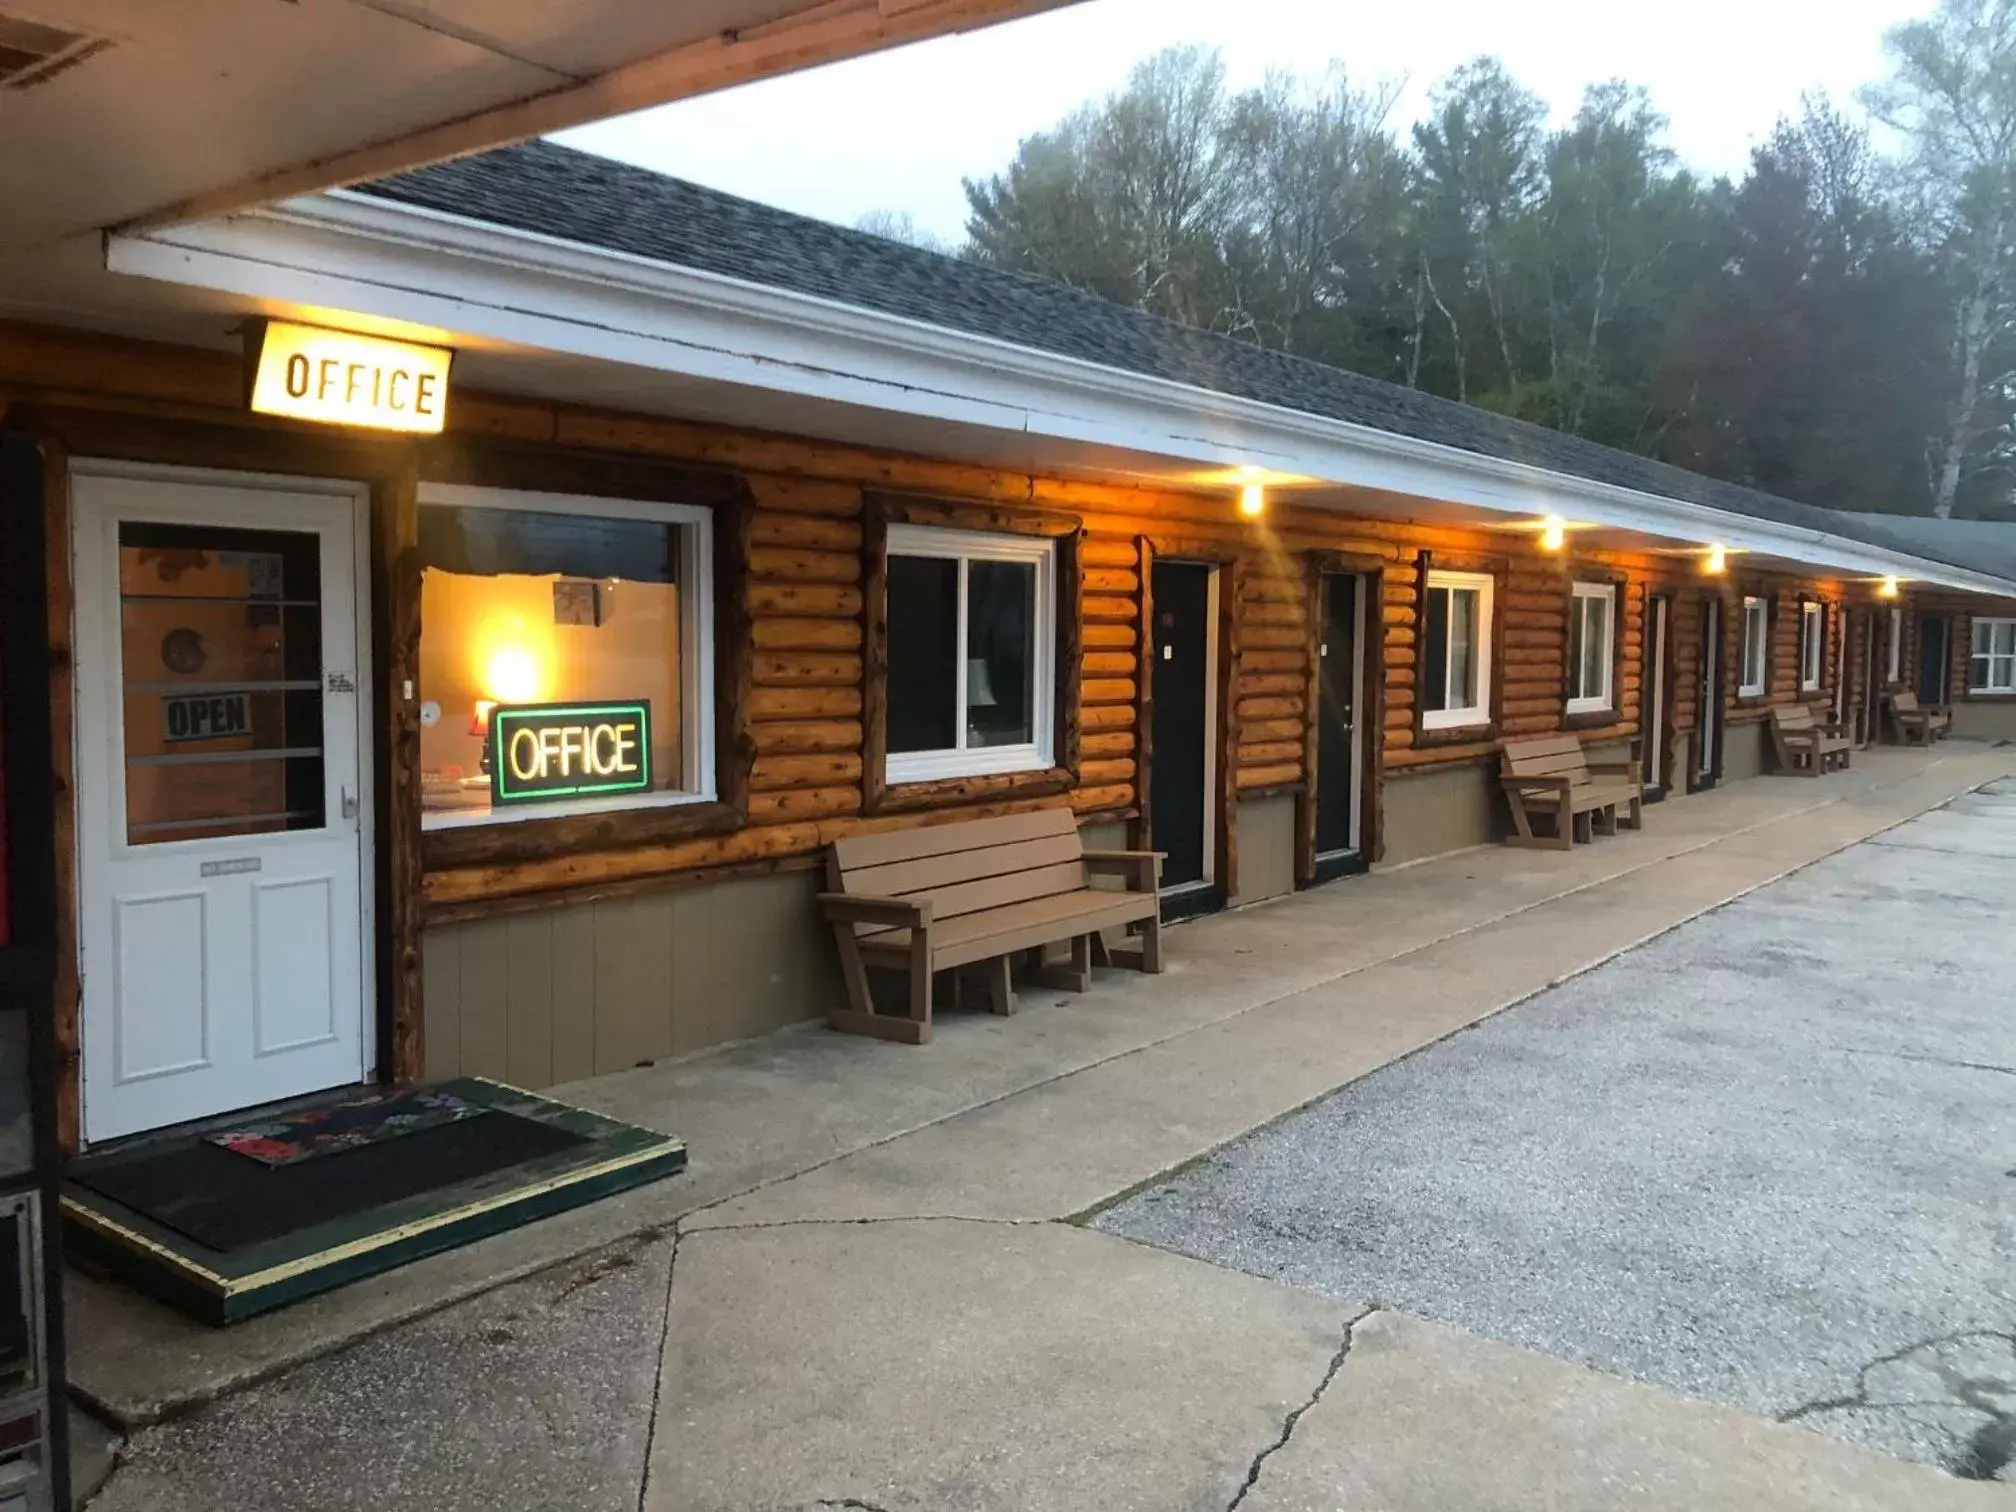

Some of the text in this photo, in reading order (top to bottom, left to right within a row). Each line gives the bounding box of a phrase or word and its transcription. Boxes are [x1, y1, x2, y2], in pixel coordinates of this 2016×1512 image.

[286, 353, 436, 415] OFFICE
[168, 696, 245, 736] OPEN
[510, 724, 637, 780] OFFICE
